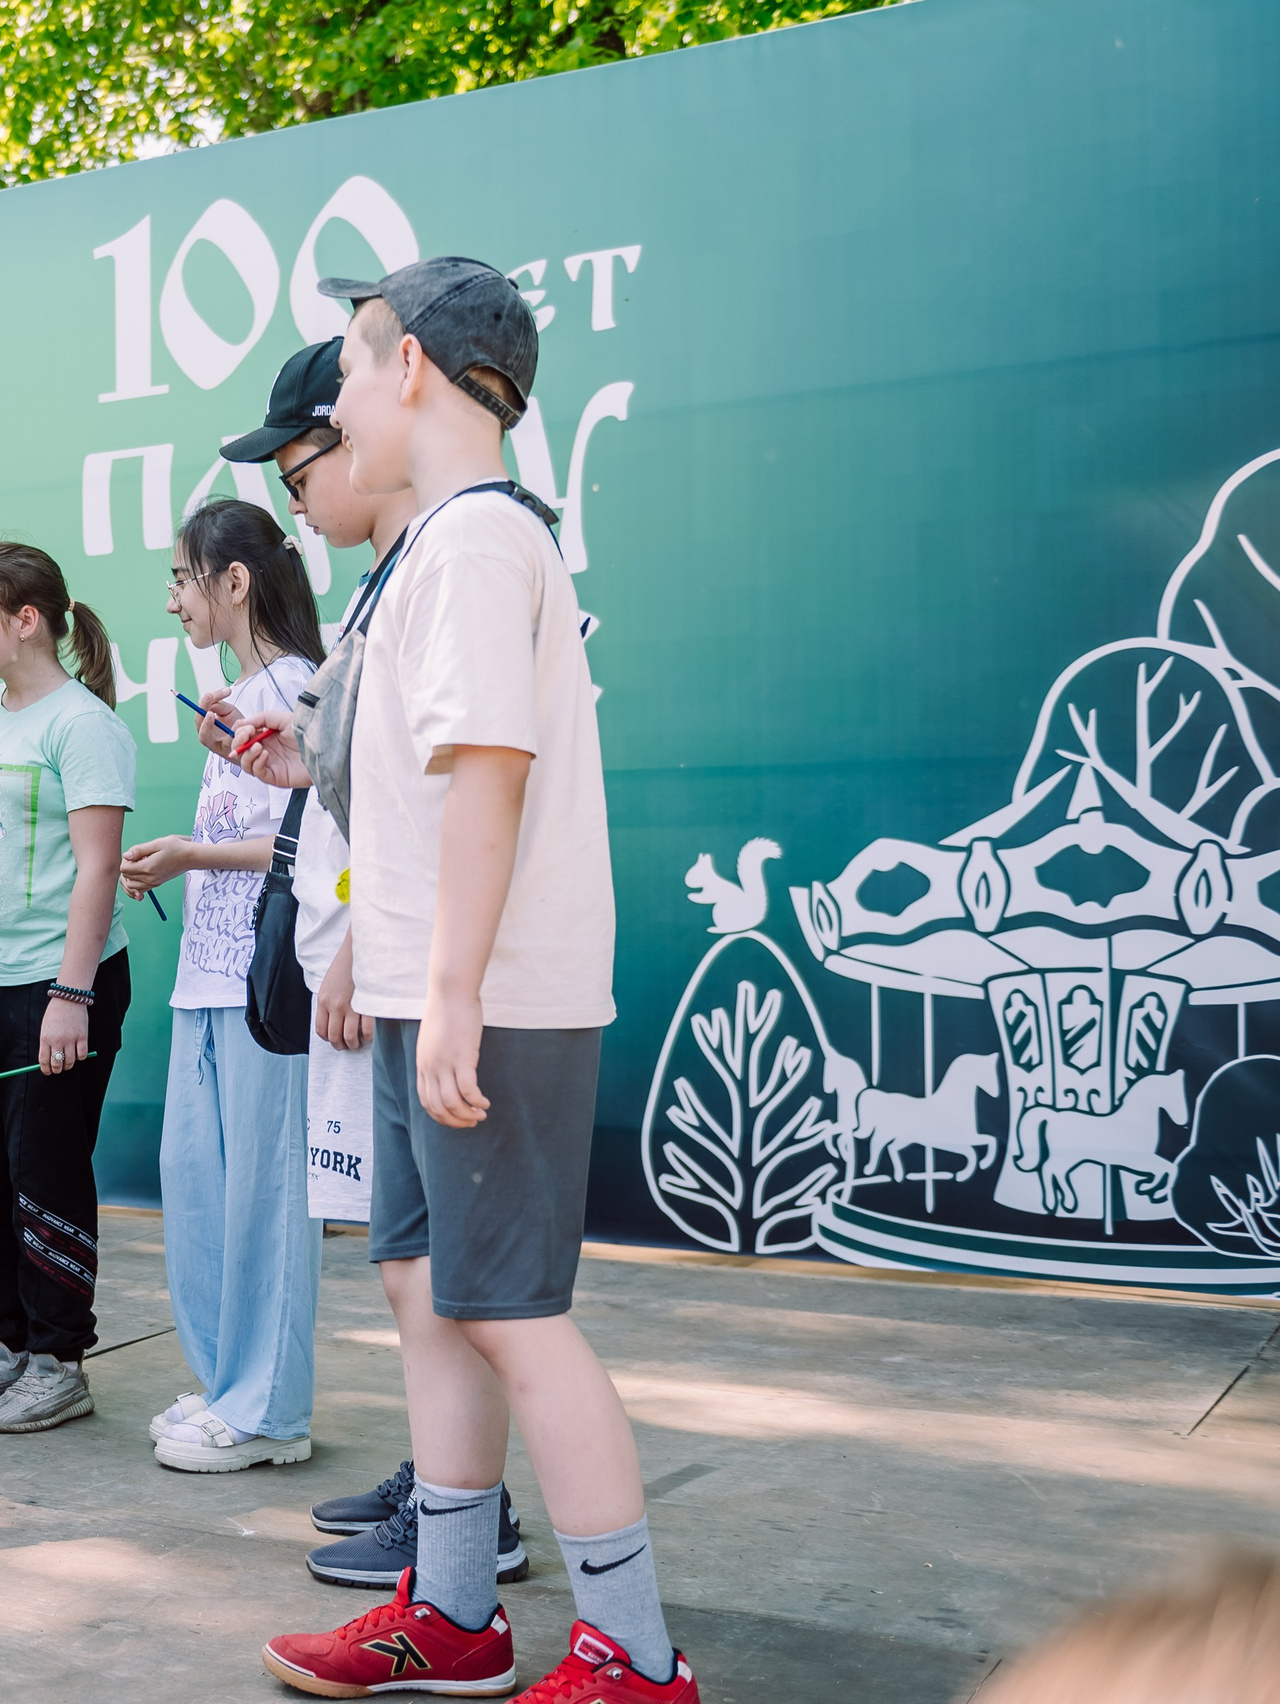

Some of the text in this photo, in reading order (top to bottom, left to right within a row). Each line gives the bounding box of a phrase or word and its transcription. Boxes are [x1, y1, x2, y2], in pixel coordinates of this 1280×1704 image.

[93, 175, 420, 403] 100
[312, 404, 336, 417] JORDA
[326, 1120, 341, 1134] 75
[310, 1147, 362, 1182] YORK
